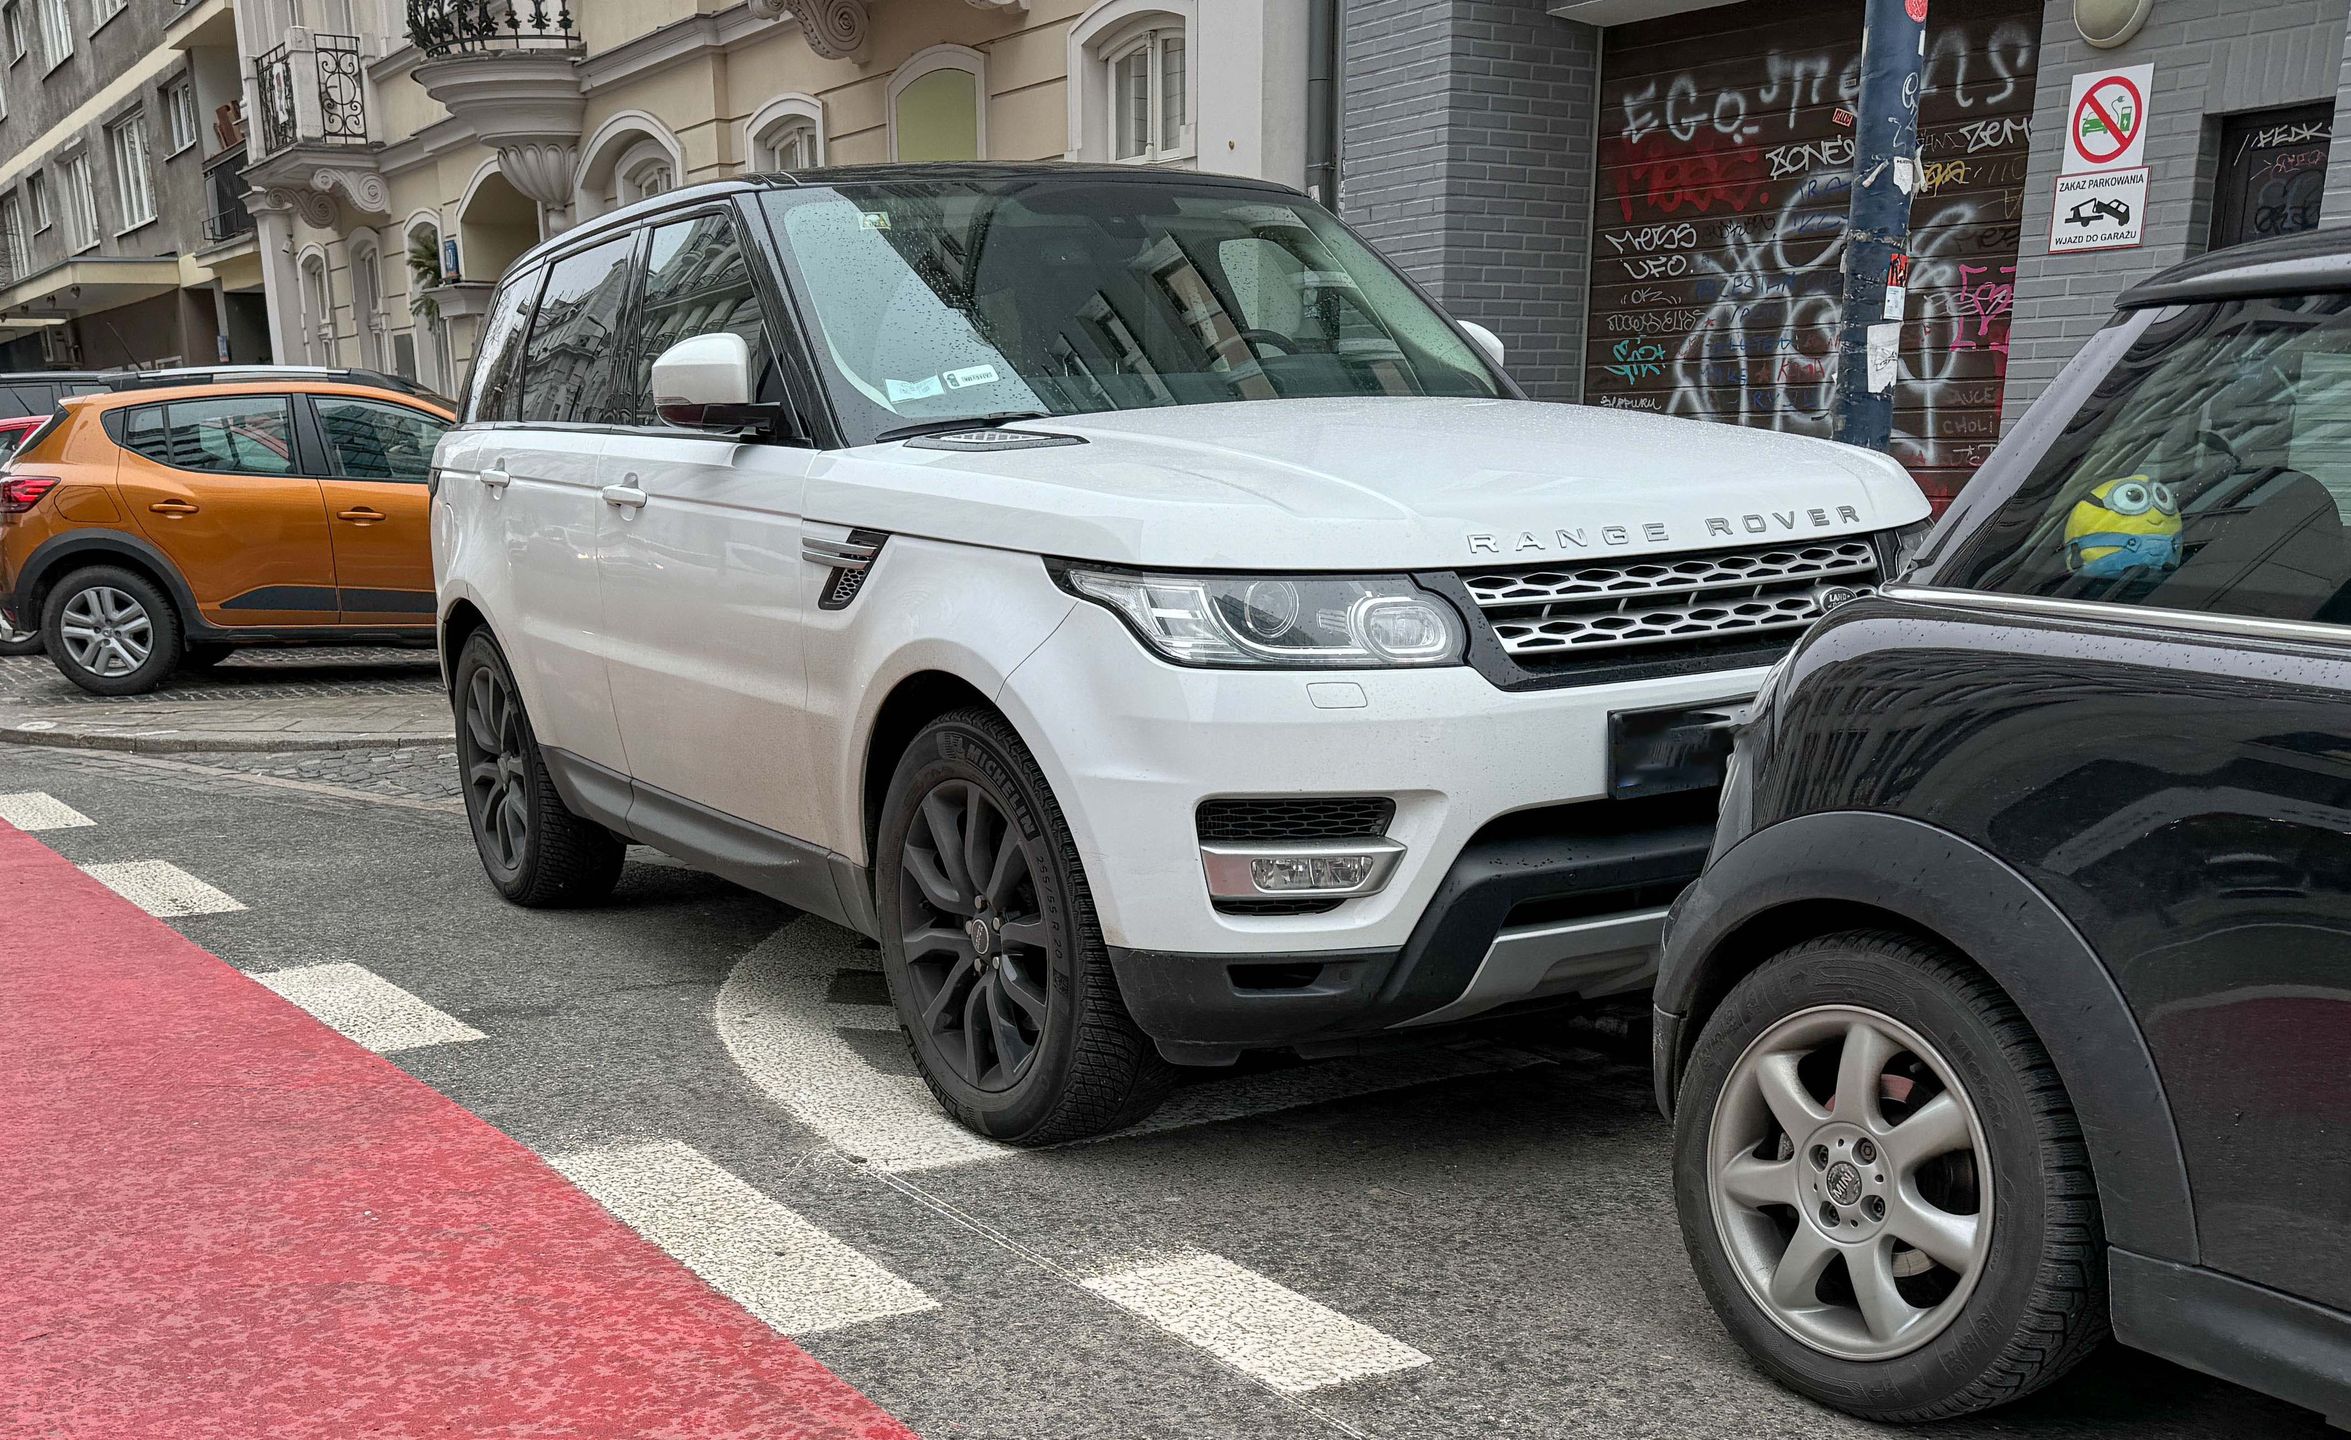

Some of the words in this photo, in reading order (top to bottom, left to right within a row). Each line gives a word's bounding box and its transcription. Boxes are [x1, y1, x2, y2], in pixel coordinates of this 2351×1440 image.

[2059, 180, 2087, 192] ZAKAZ
[2088, 174, 2144, 188] PARKOWANIA
[2055, 235, 2083, 245] WJAZD
[2086, 234, 2098, 242] DO
[2100, 230, 2137, 241] GARAŻU
[1467, 521, 1669, 554] RANGE
[1705, 504, 1860, 536] ROVER
[967, 743, 1036, 834] MICHELIN
[1832, 1168, 1855, 1199] MINI
